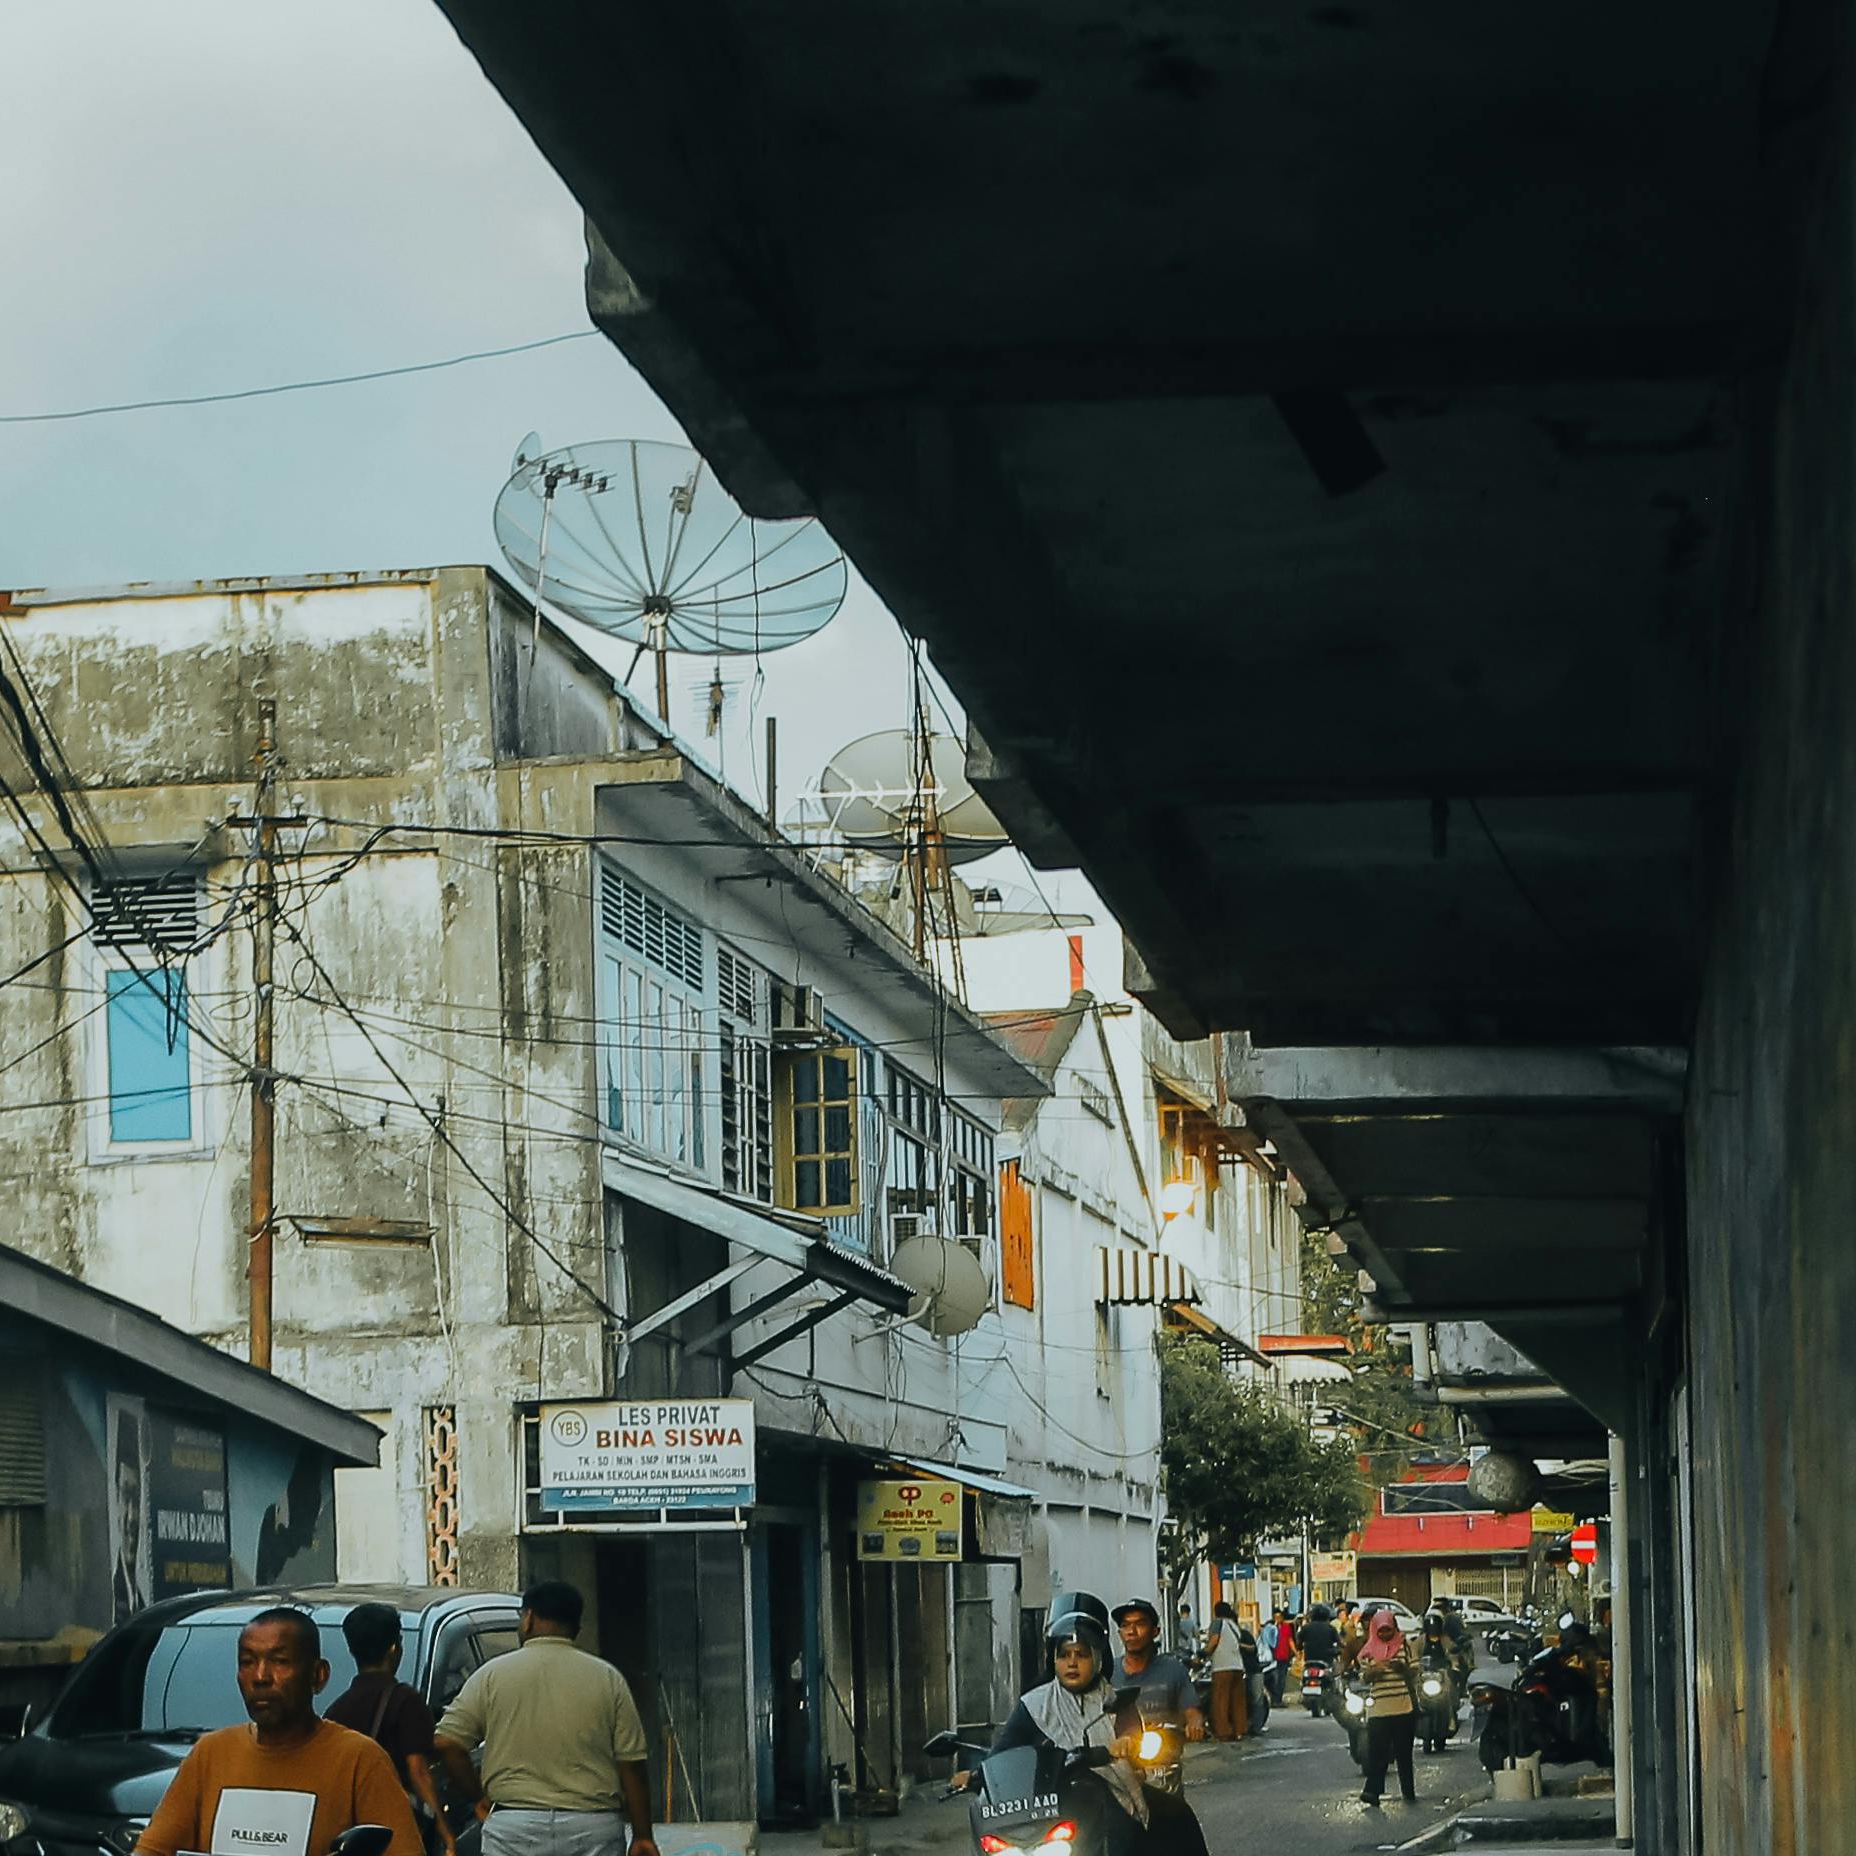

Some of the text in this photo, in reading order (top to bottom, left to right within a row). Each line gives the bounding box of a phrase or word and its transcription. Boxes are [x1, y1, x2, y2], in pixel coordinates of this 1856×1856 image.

[619, 1405, 721, 1426] LES PRIVAT
[558, 1421, 581, 1436] YBS
[596, 1428, 743, 1448] BINA SISWA
[578, 1457, 590, 1466] TK
[641, 1455, 659, 1465] SMP
[698, 1453, 718, 1464] SMA
[553, 1467, 746, 1481] PELAJARAN SEKOLAH DAN BAHASA INGGRIS
[981, 1804, 998, 1819] BL
[231, 1830, 288, 1843] PULL&BEAR
